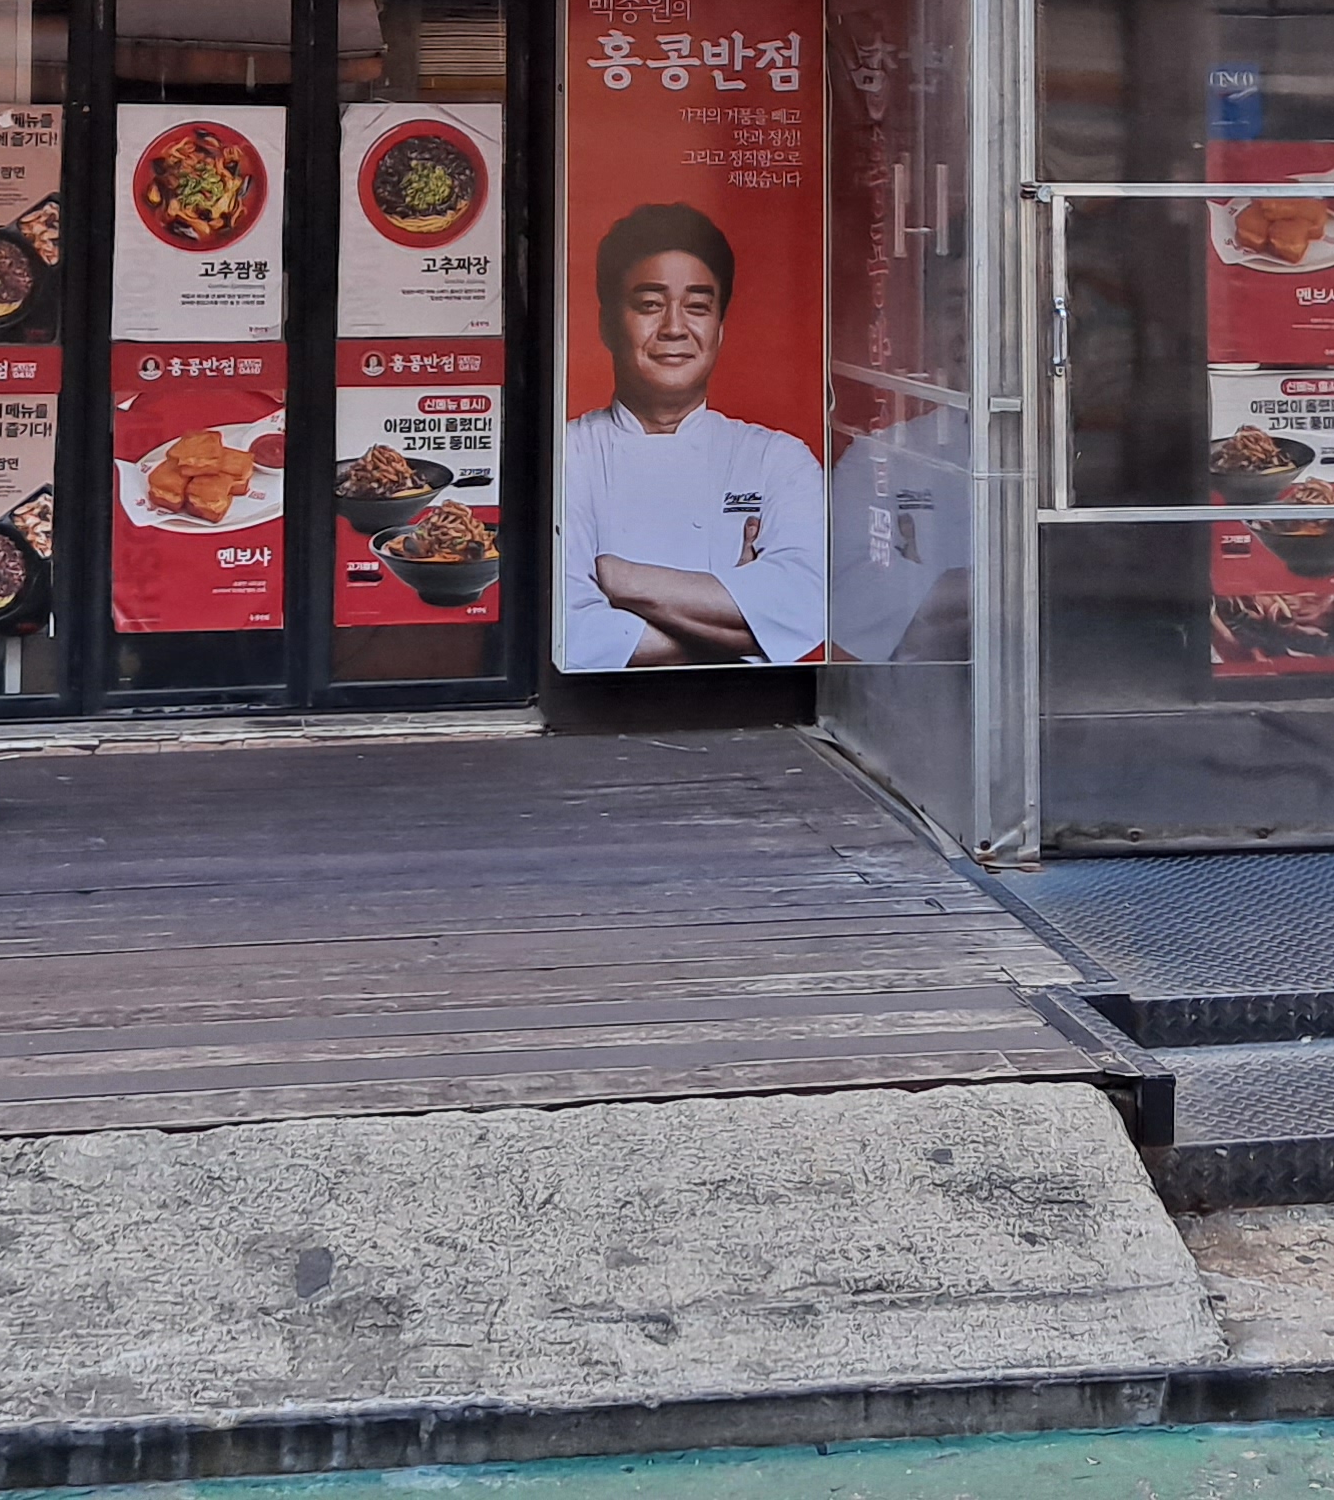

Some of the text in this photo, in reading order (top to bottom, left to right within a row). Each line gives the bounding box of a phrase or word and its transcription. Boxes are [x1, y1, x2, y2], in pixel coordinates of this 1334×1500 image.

[586, 29, 802, 92] 홍콩반점
[679, 107, 802, 124] 가격의 거품을 빼고
[733, 129, 802, 147] 맛과 정성!
[681, 149, 803, 167] 그리고 정직함으로
[727, 170, 803, 189] 채웠습니다
[198, 259, 271, 280] 고추짬뽕
[421, 255, 490, 276] 고추짜장
[166, 357, 235, 377] 홍콩반점
[388, 353, 455, 374] 홍콩반점
[6, 403, 48, 419] 메뉴를
[383, 417, 442, 434] 아낌없이
[402, 435, 492, 451] 고기도 풍미도
